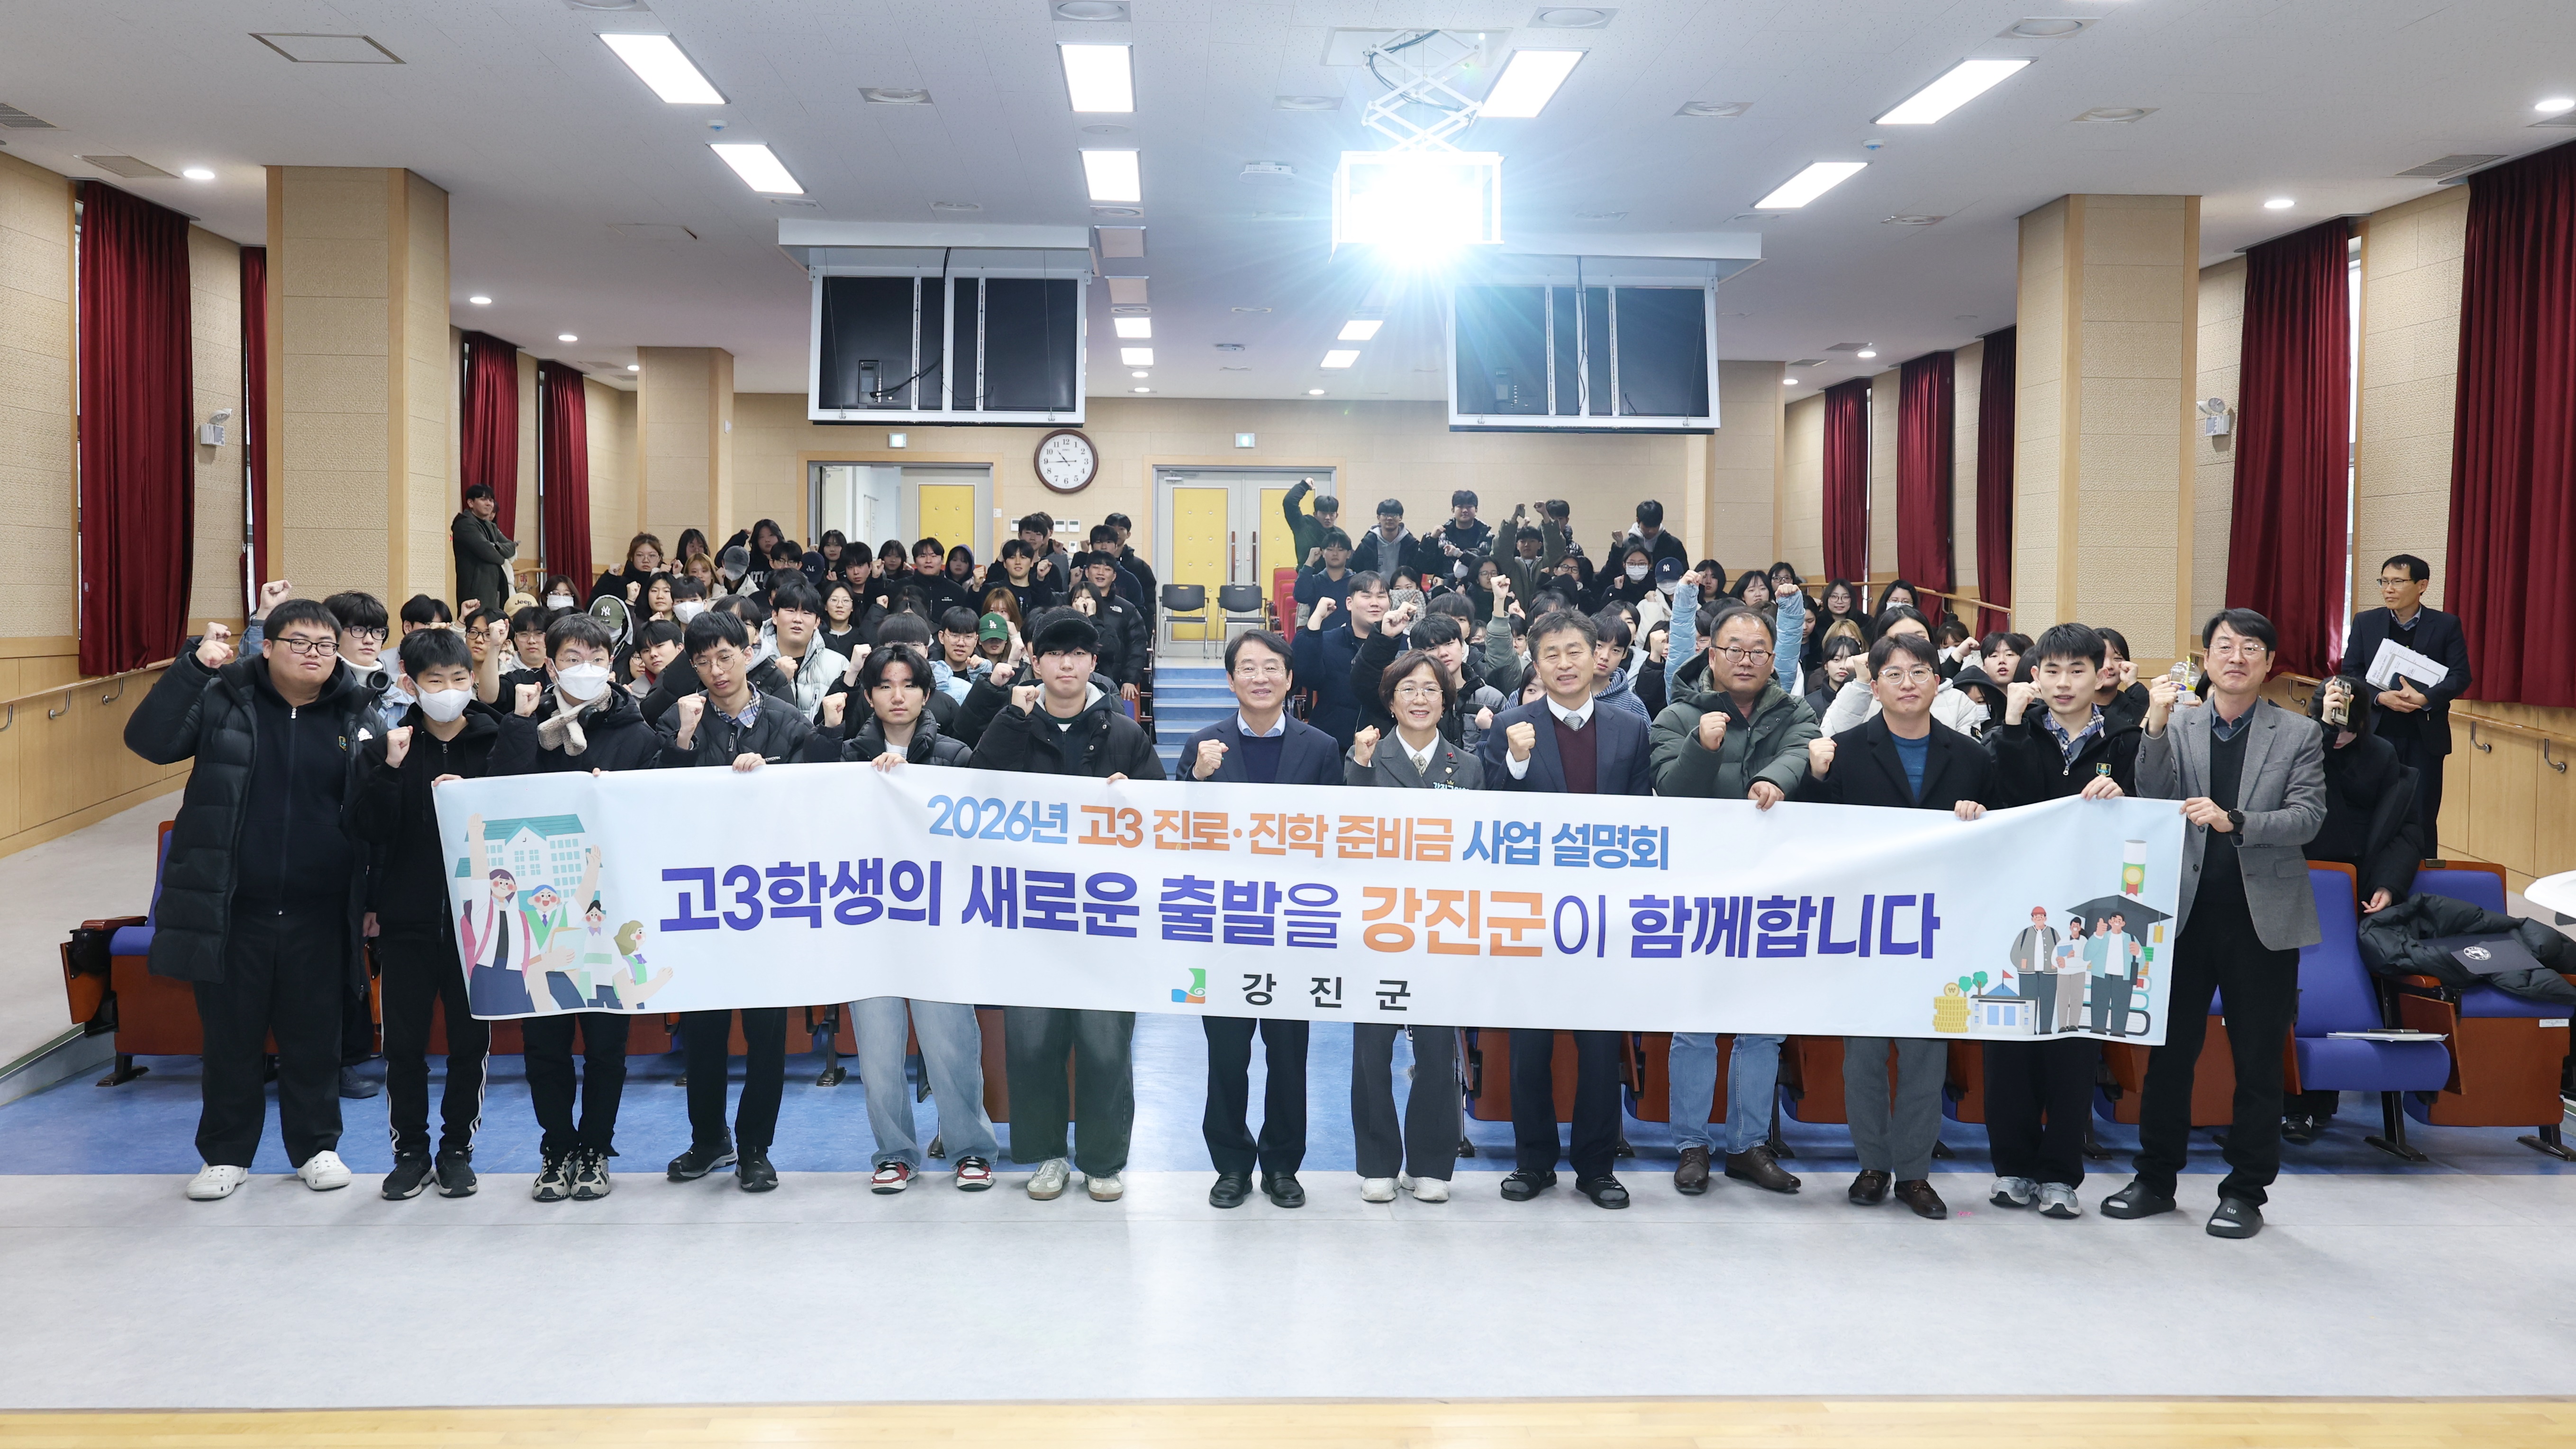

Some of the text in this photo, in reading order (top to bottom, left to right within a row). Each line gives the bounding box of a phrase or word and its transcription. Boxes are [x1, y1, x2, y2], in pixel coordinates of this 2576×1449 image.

[989, 620, 997, 629] LA
[928, 795, 1068, 844] 2026년
[1079, 805, 1143, 848] 고3
[1336, 815, 1453, 861] 준비금
[1463, 821, 1541, 865] 사업
[1552, 824, 1668, 870] 설명회
[661, 858, 1940, 959] 고3학생의 새로운 출발을 강진군이 함께합니다
